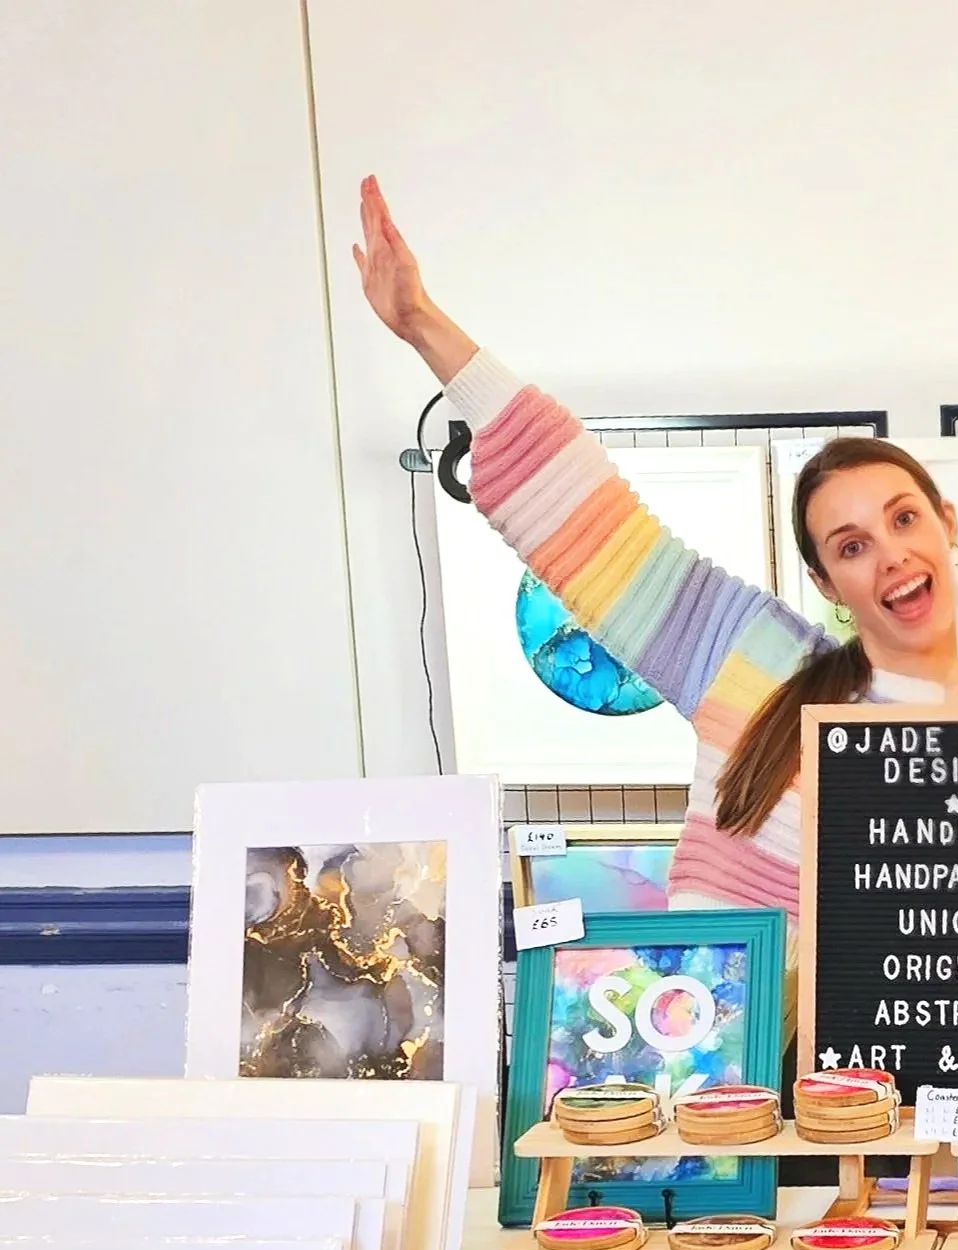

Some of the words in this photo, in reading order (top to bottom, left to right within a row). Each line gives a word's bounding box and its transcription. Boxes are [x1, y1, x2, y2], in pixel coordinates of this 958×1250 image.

[532, 916, 558, 931] £65
[847, 1044, 907, 1073] ART
[938, 1045, 958, 1073] &
